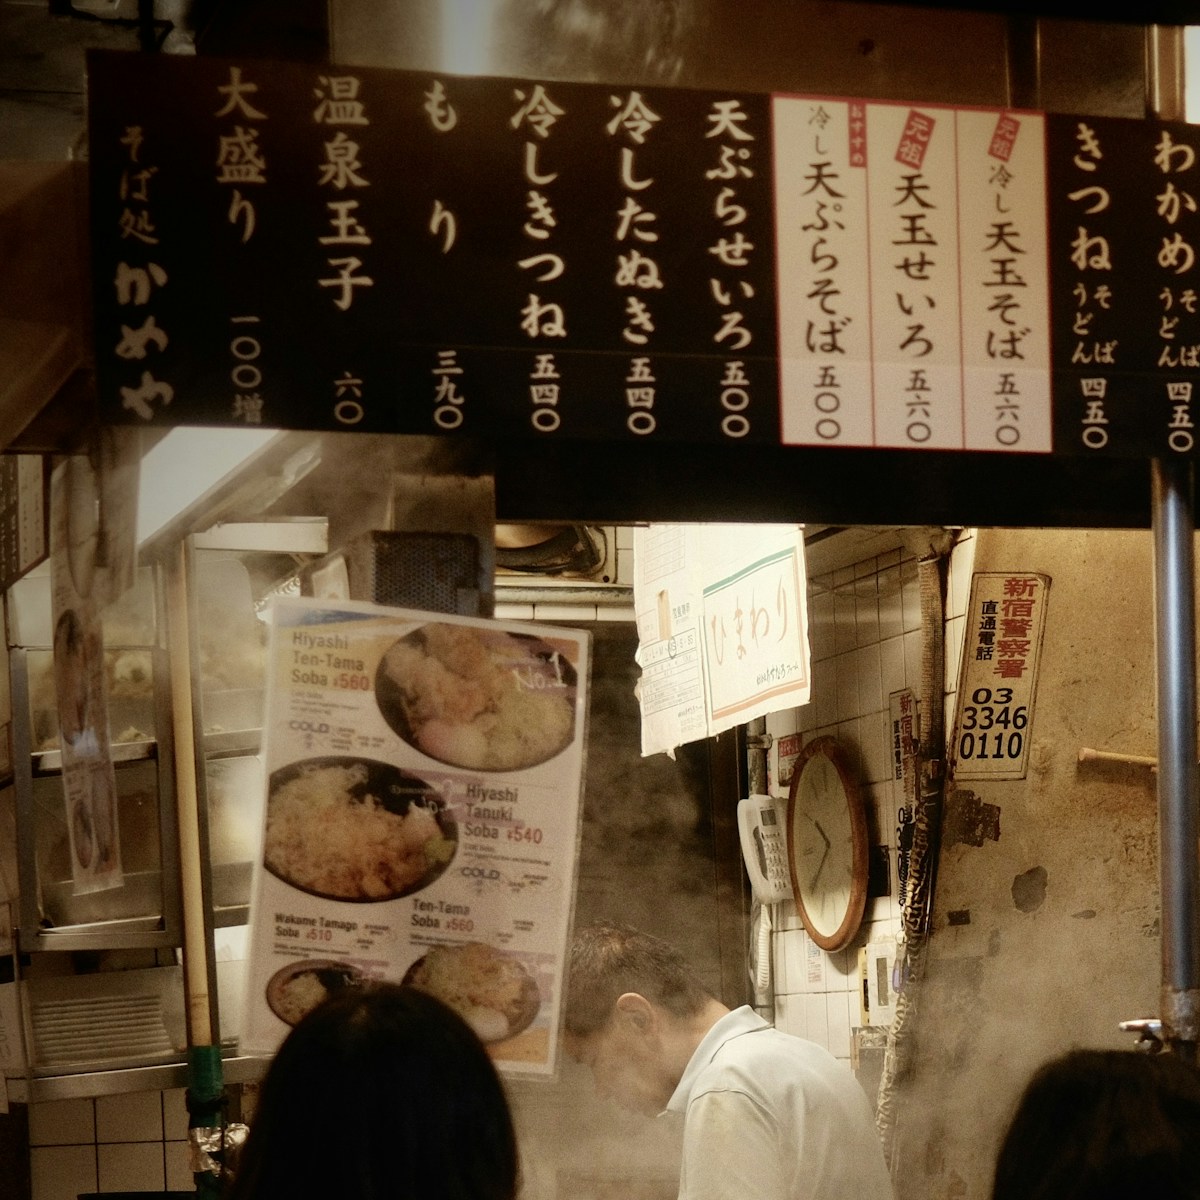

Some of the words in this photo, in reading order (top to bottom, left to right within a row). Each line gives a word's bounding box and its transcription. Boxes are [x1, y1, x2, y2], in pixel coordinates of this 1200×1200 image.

[214, 66, 268, 244] 大盛り
[425, 80, 457, 254] もり
[850, 104, 864, 164] おすすめ
[899, 115, 929, 166] 元祖
[120, 126, 159, 244] そば処
[313, 75, 374, 312] 温泉玉子
[510, 84, 567, 338] 冷しきつね
[606, 91, 664, 345] 冷したぬき
[1067, 123, 1112, 270] きつね
[1154, 131, 1197, 275] わかめ
[705, 100, 755, 350] 天ぷらせいろ
[892, 173, 938, 358] 天玉せいろ
[114, 261, 174, 421] かめや
[334, 371, 364, 424] 六〇
[432, 350, 465, 429] 三九〇
[530, 353, 561, 433] 五四〇
[626, 357, 656, 435] 五四〇
[720, 361, 750, 438] 五〇〇
[813, 365, 841, 440] 五〇〇
[905, 369, 932, 443] 五六〇
[994, 372, 1021, 446] 五六〇
[1080, 377, 1109, 449] 四五〇
[1167, 382, 1195, 453] 四五〇
[292, 631, 349, 650] Hiyashi
[293, 650, 364, 672] Ten-Tama
[976, 600, 999, 661] 直通電話
[993, 577, 1038, 679] 新宿警察署
[291, 668, 328, 687] Soba
[972, 688, 1014, 705] 03
[289, 719, 330, 734] COLD
[960, 732, 1023, 760] 0110
[962, 706, 1028, 730] 3346
[466, 783, 519, 803] Hiyashi
[466, 802, 513, 822] Tanuki
[464, 823, 499, 840] Soba
[412, 898, 471, 916] Ten-Tama
[461, 866, 501, 881] COLD
[275, 913, 317, 927] Wakame
[319, 917, 358, 932] Tamago
[275, 926, 300, 938] Soba
[411, 913, 440, 928] Soba
